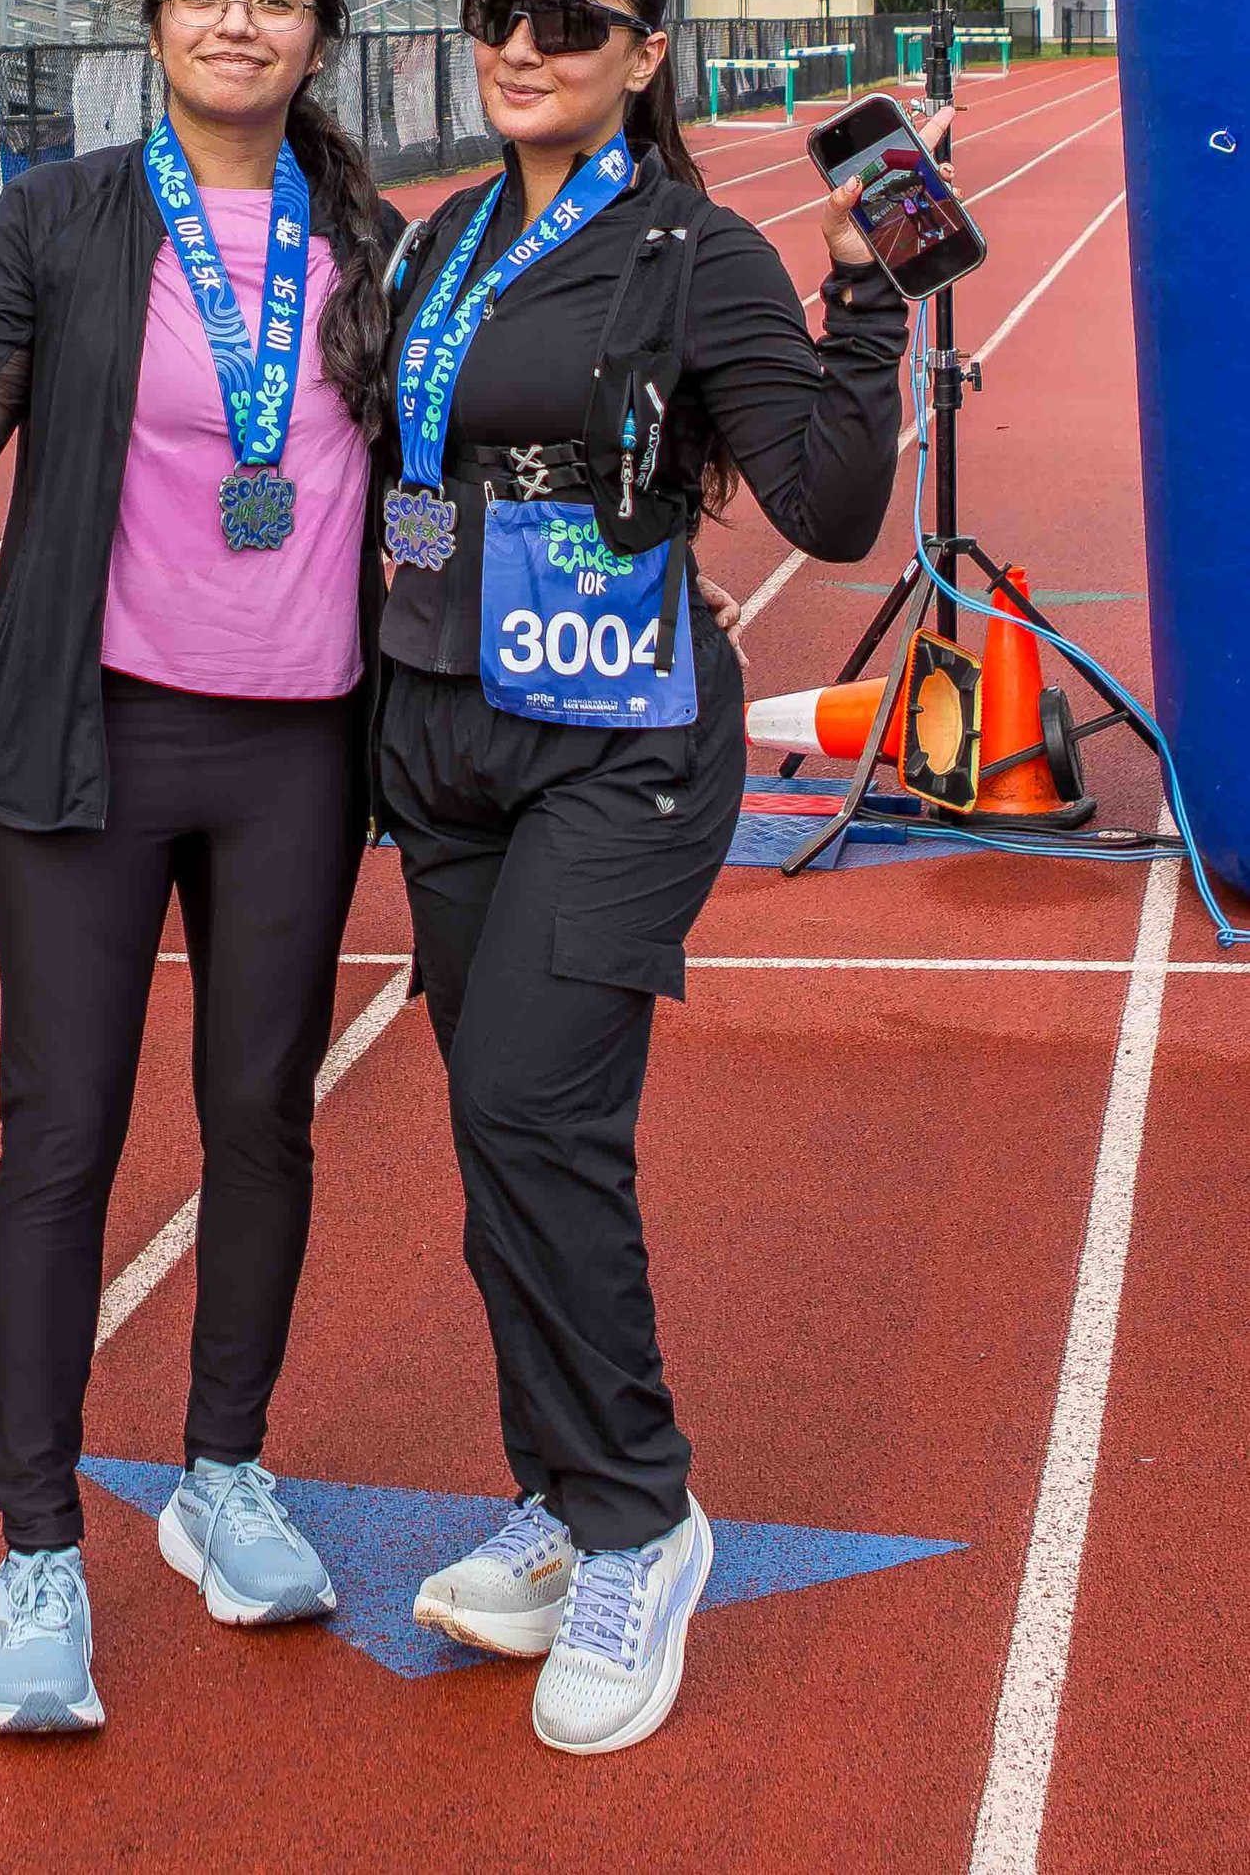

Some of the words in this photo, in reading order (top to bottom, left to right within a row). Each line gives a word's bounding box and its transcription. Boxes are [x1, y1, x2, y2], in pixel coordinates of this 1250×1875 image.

[148, 136, 191, 209] LAKES
[174, 215, 205, 249] 10K
[192, 265, 221, 291] 5K
[276, 217, 293, 245] PR
[272, 275, 299, 303] 5K
[265, 317, 294, 351] 10K
[421, 347, 455, 441] SOUTH
[507, 236, 544, 265] 10K
[553, 199, 583, 231] 5K
[405, 338, 430, 373] 10K
[252, 363, 289, 454] LAKES
[549, 517, 599, 544] SOU
[548, 541, 634, 577] LAKES
[577, 571, 607, 597] 10K
[500, 609, 676, 677] 3004
[530, 1558, 563, 1584] BROOKS
